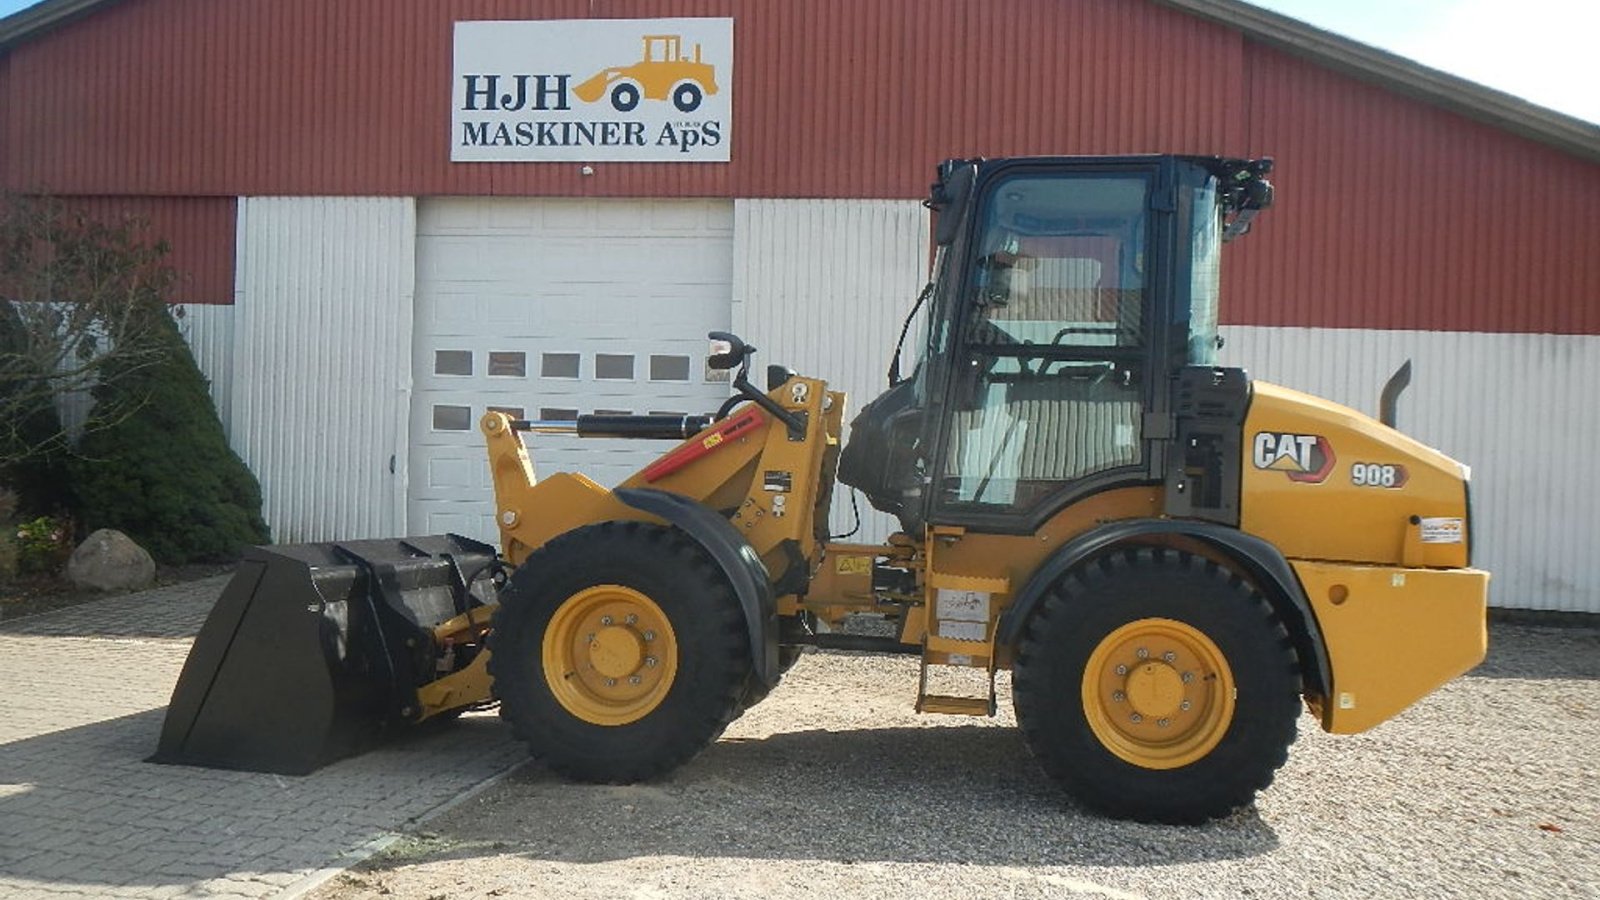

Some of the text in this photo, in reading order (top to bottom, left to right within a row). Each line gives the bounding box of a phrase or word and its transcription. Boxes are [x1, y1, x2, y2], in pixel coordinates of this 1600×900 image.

[461, 74, 572, 112] HJH
[461, 120, 721, 152] MASKINER ApS
[1254, 432, 1318, 472] CAT
[1352, 463, 1396, 487] 908
